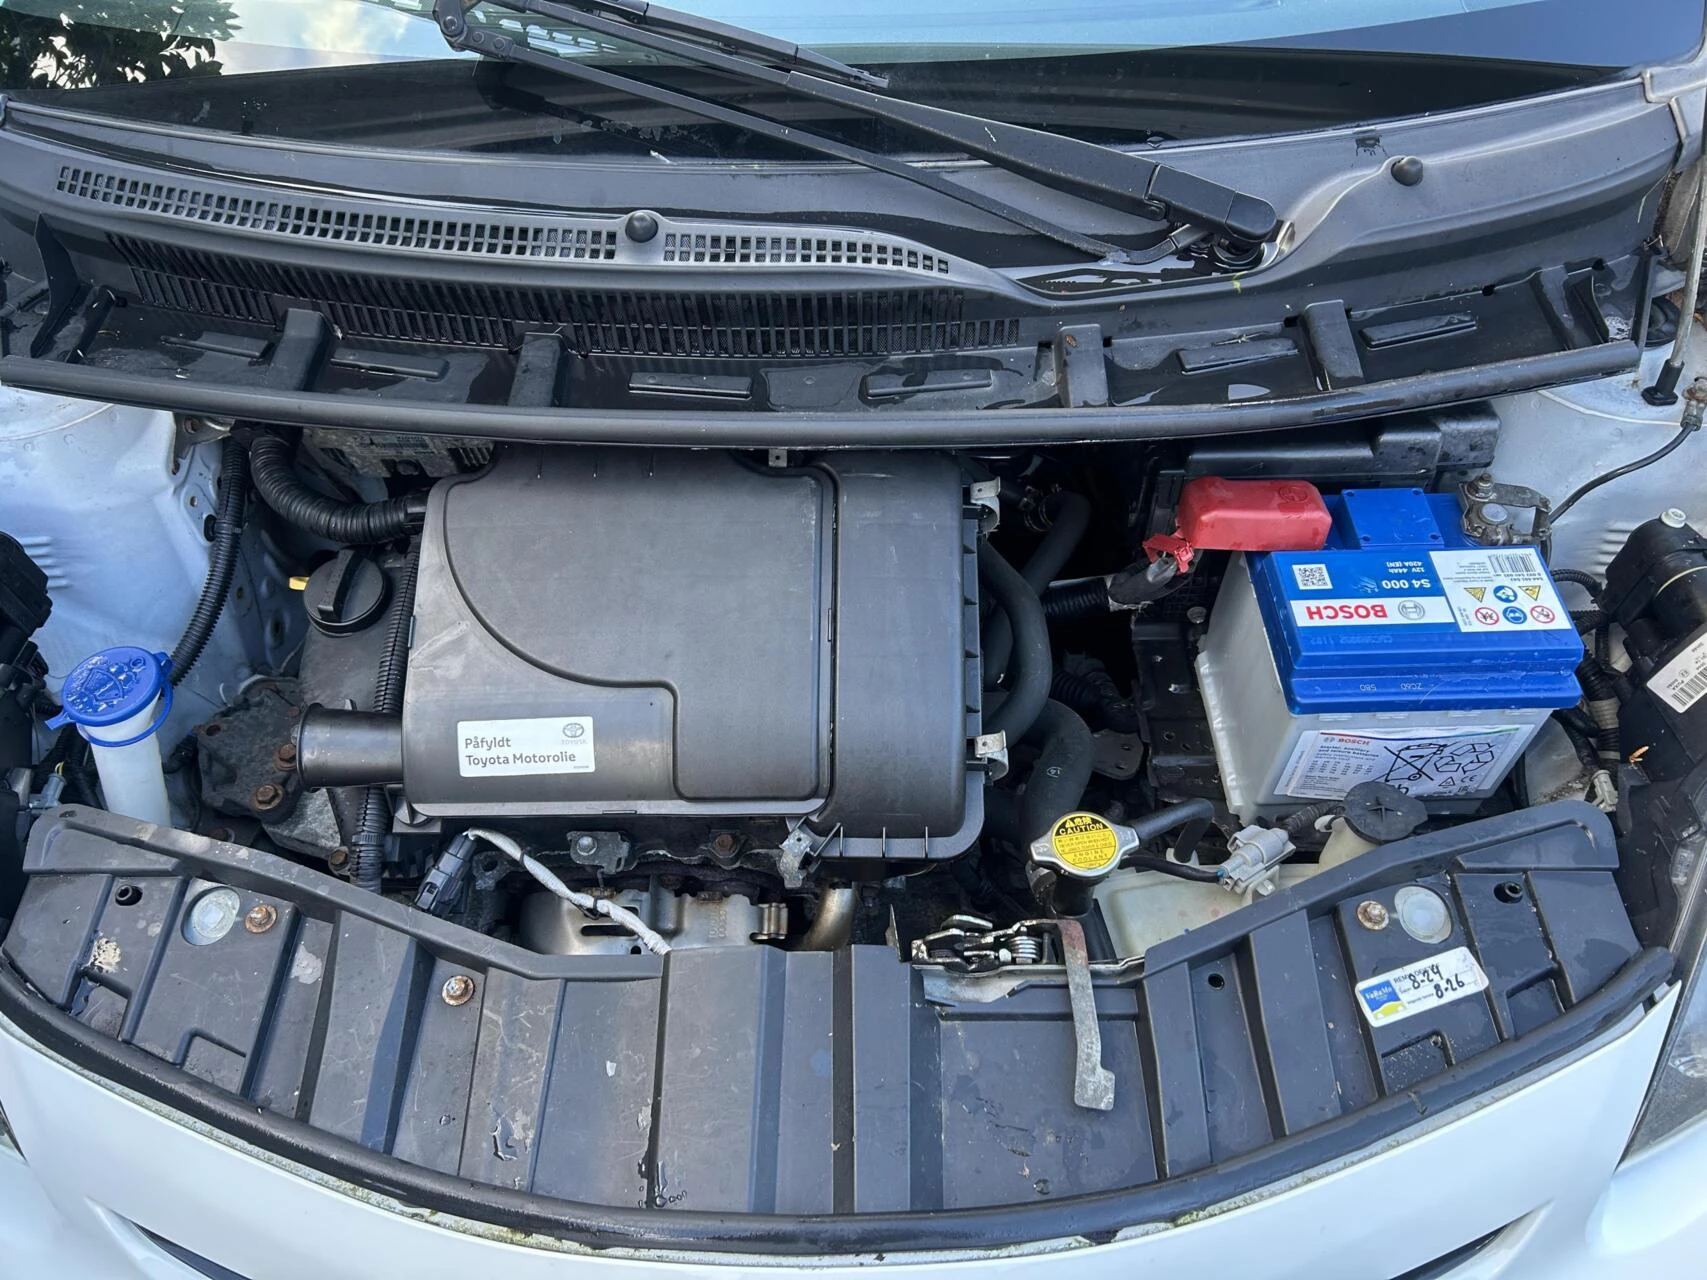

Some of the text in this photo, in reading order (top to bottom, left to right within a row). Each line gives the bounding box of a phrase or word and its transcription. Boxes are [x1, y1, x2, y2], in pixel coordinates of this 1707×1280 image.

[1381, 578, 1431, 589] S4 000
[1305, 604, 1388, 620] BOSCH
[465, 736, 511, 750] Påfyldt
[1337, 738, 1370, 746] BOSCH
[465, 751, 576, 768] Toyota Motorolie
[1059, 823, 1103, 835] CAUTION
[1408, 964, 1443, 990] 8-24
[1433, 973, 1465, 999] 8-26
